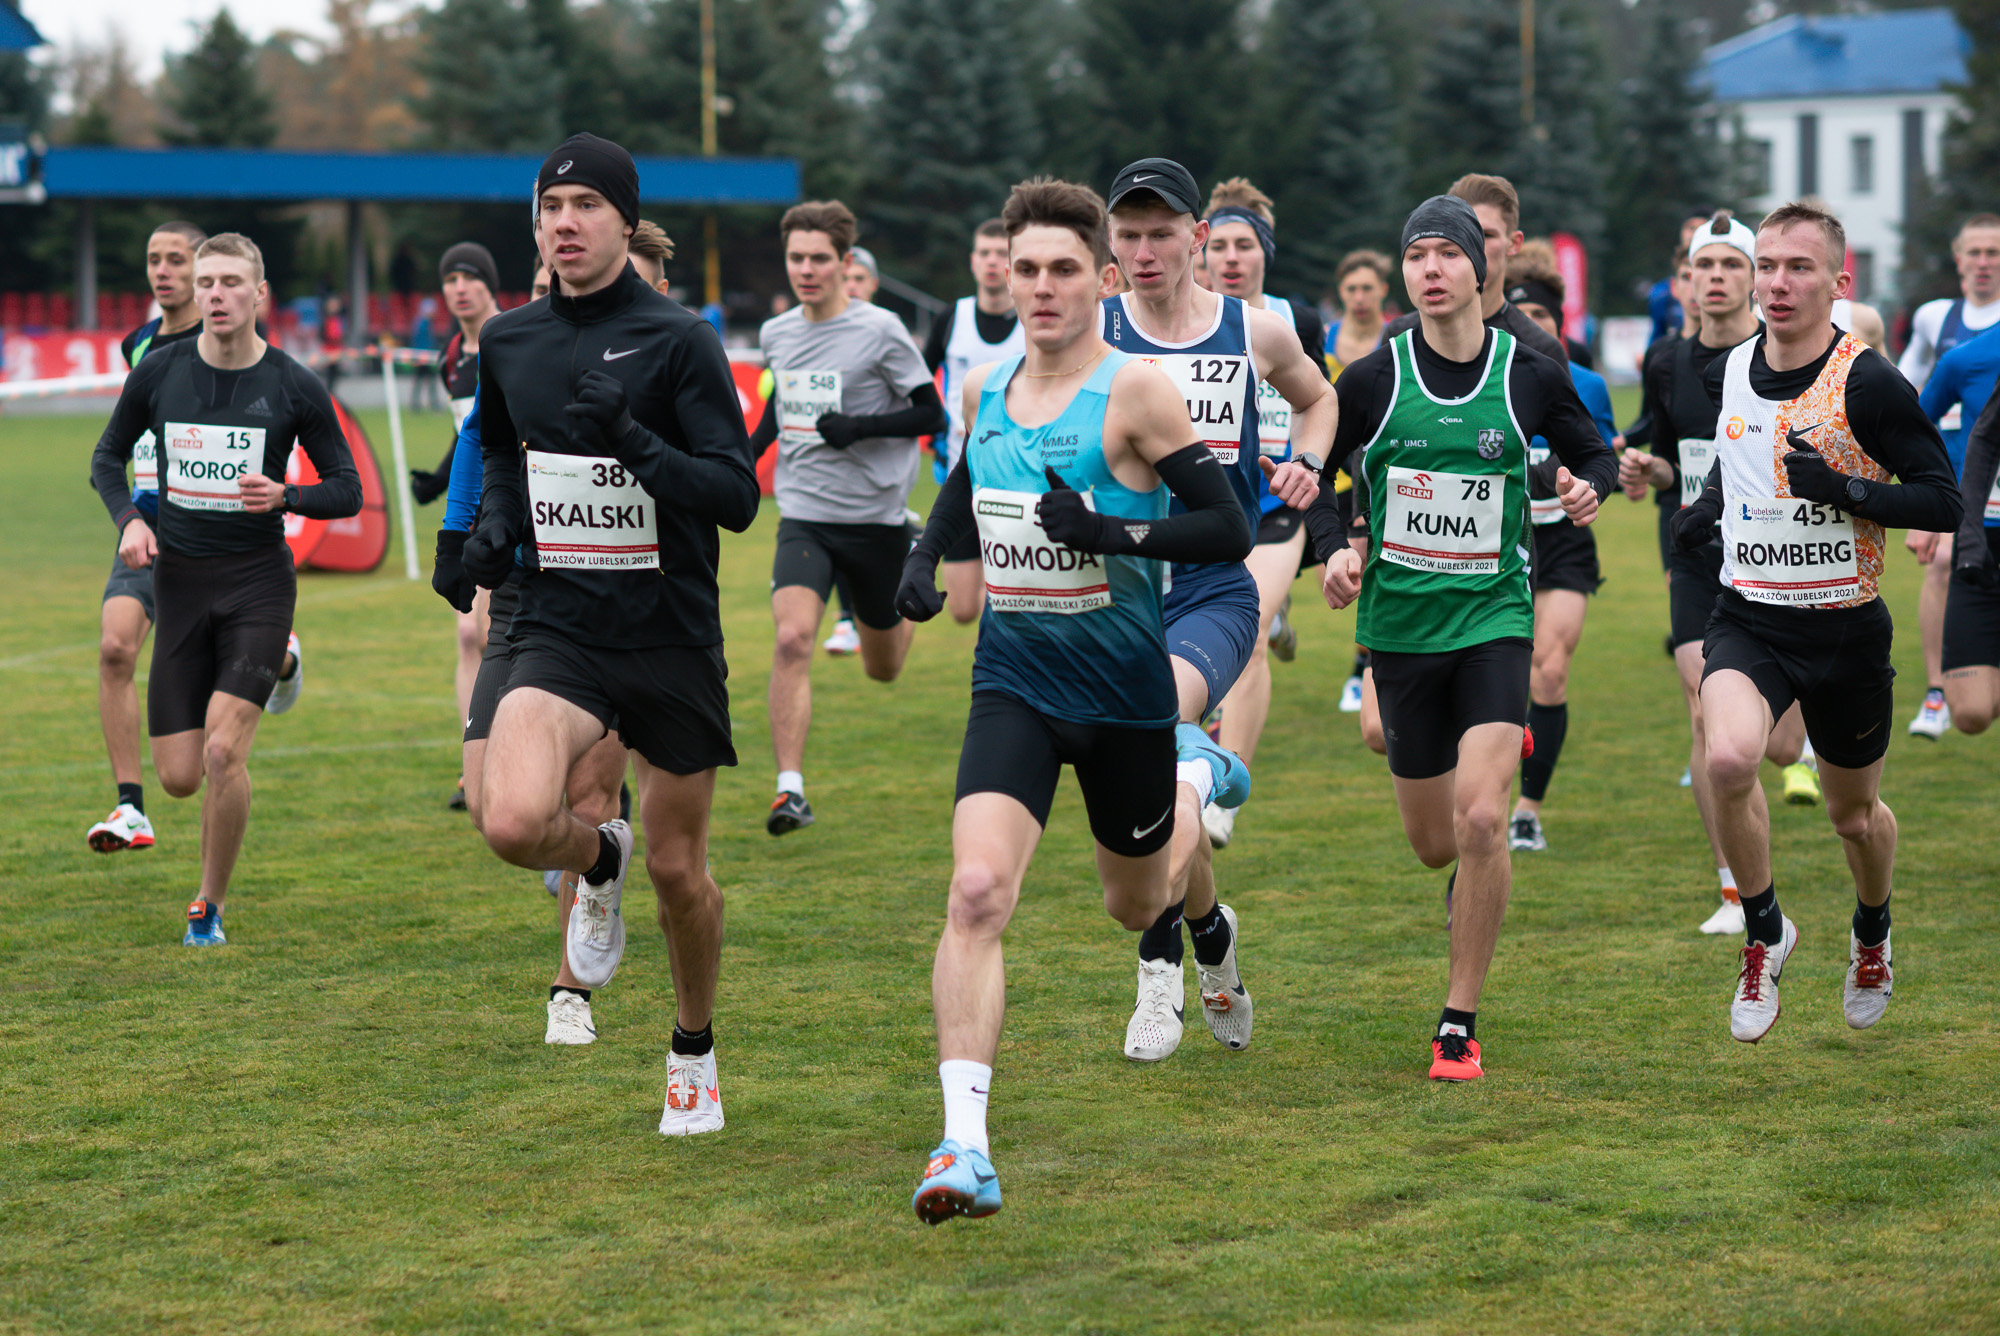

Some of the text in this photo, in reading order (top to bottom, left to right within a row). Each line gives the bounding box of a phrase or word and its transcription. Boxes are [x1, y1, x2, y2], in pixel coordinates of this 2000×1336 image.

[1190, 359, 1241, 384] 127
[810, 375, 835, 391] 548
[1747, 424, 1762, 433] NN
[226, 431, 251, 450] 15
[1042, 434, 1079, 448] WMLKS
[1404, 439, 1428, 448] UMCS
[1041, 449, 1078, 459] Pomorze
[1217, 451, 1233, 460] 2021
[179, 459, 249, 481] KOROŚ
[1399, 486, 1431, 499] ORLEN
[1461, 479, 1490, 501] 78
[171, 496, 207, 507] TOMASZÓW
[208, 501, 239, 509] LUBELSKI
[535, 501, 645, 529] SKALSKI
[1751, 507, 1784, 516] lubelskie
[1792, 503, 1846, 527] 451
[1406, 511, 1479, 538] KUNA
[538, 554, 654, 566] OMASZÓW LUBELSKI 2021
[982, 539, 1100, 571] KOMODA
[1736, 540, 1852, 567] ROMBERG
[1386, 552, 1493, 571] TOMASZÓW LUBELSKI 2021
[1739, 588, 1855, 602] TOMASZÓW LUBELSKI 2021
[1039, 599, 1078, 609] LUBELSKI
[1082, 597, 1105, 608] 2021
